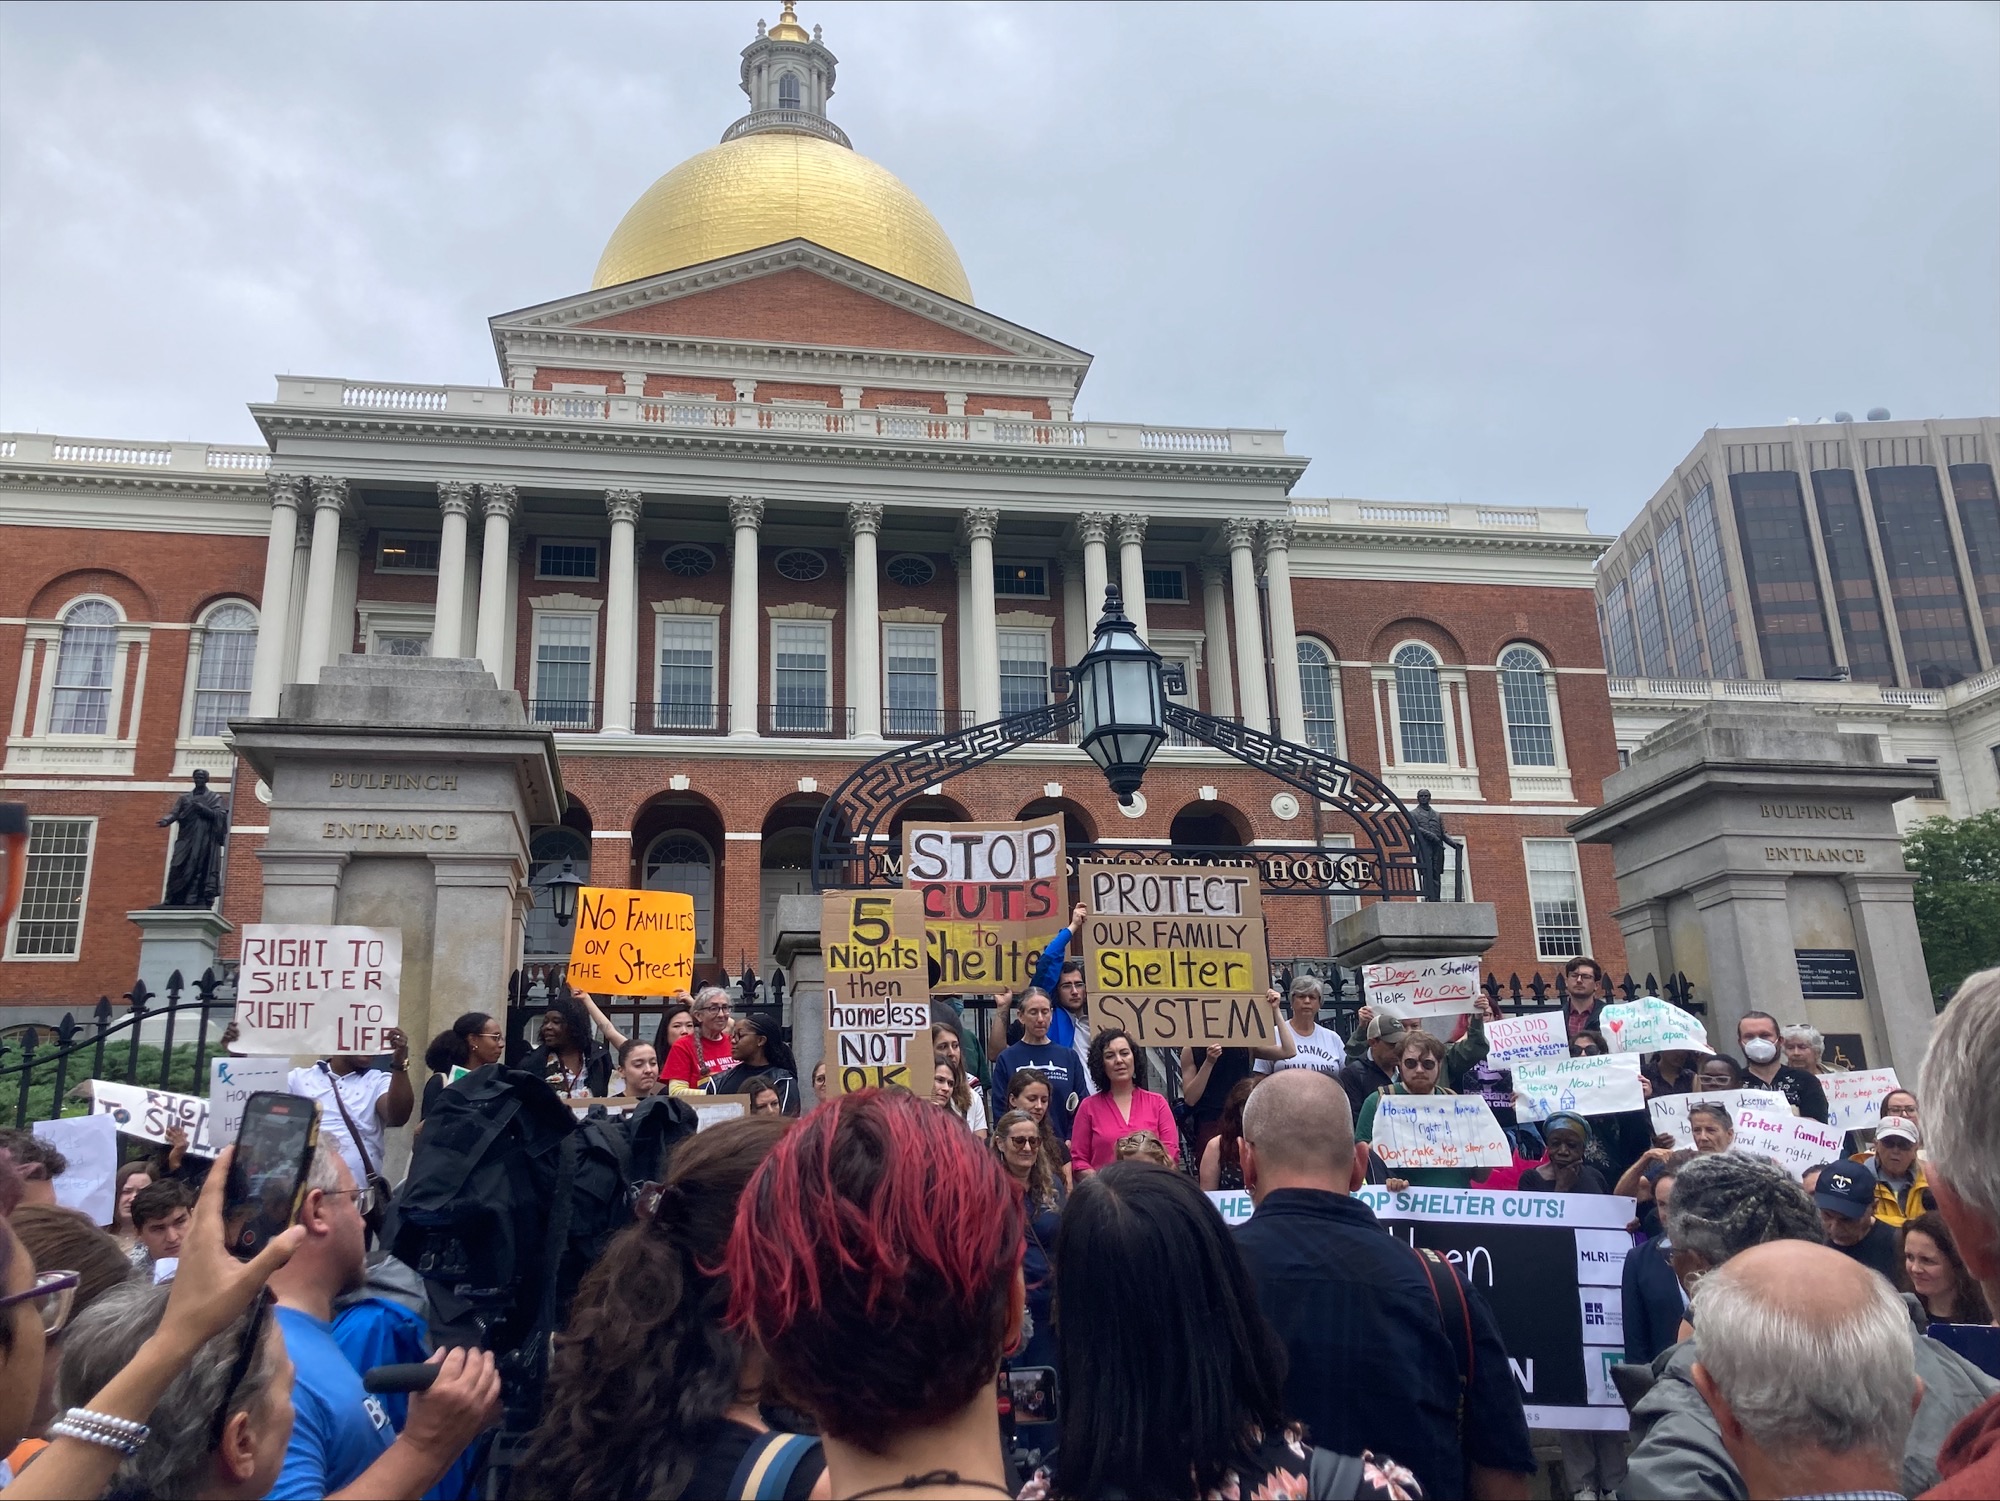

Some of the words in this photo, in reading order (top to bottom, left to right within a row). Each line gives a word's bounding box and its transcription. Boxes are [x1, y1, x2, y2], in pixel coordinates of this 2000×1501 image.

[330, 772, 458, 791] BULFINCH
[1760, 804, 1855, 820] BULFINCH
[323, 822, 458, 840] ENTRANCE
[911, 828, 1056, 880] STOP
[1765, 847, 1866, 863] ENTRANCE
[1267, 860, 1373, 881] HOUSE
[922, 881, 1051, 920] CUTS
[1093, 871, 1249, 914] PROTECT
[852, 897, 892, 946] 5
[972, 922, 998, 948] to
[1093, 920, 1146, 946] OUR
[1152, 921, 1248, 949] FAMILY
[243, 938, 328, 967] RIGHT
[348, 940, 383, 968] TO
[570, 962, 602, 979] THE
[615, 942, 692, 985] Streets
[830, 938, 919, 975] Nights
[926, 930, 1048, 982] helte
[250, 969, 382, 994] SHELTER
[1100, 951, 1244, 988] Shelter
[1368, 966, 1382, 983] 5
[1385, 965, 1417, 984] Days
[1421, 967, 1436, 978] in
[1440, 961, 1479, 976] Shelter
[848, 973, 902, 999] then
[1375, 992, 1406, 1004] Helps
[237, 1000, 315, 1030] RIGHT
[350, 1003, 383, 1023] TO
[829, 989, 927, 1028] homeless
[1097, 995, 1267, 1040] SYSTEM
[1489, 1021, 1522, 1039] KIDS
[1524, 1018, 1548, 1032] DID
[841, 1033, 914, 1066] NOT
[1297, 1044, 1333, 1062] CANNOT
[1493, 1032, 1550, 1051] NOTHING
[1503, 1046, 1534, 1056] DESERVE
[1534, 1049, 1560, 1057] STREET
[842, 1066, 909, 1094] OK
[1518, 1066, 1546, 1080] Build
[1556, 1057, 1613, 1075] Affordable
[1527, 1084, 1558, 1096] Housing
[1655, 1101, 1676, 1118] No
[1679, 1122, 1692, 1135] to
[1739, 1112, 1783, 1134] Protect
[1412, 1144, 1434, 1157] make
[1488, 1142, 1503, 1151] on
[1734, 1132, 1756, 1147] Fund
[1761, 1139, 1781, 1153] the
[1786, 1146, 1813, 1162] right
[1432, 1157, 1463, 1167] street
[1396, 1192, 1496, 1216] SHELTER
[1502, 1197, 1566, 1219] CUTS!
[1580, 1250, 1609, 1263] MLRI
